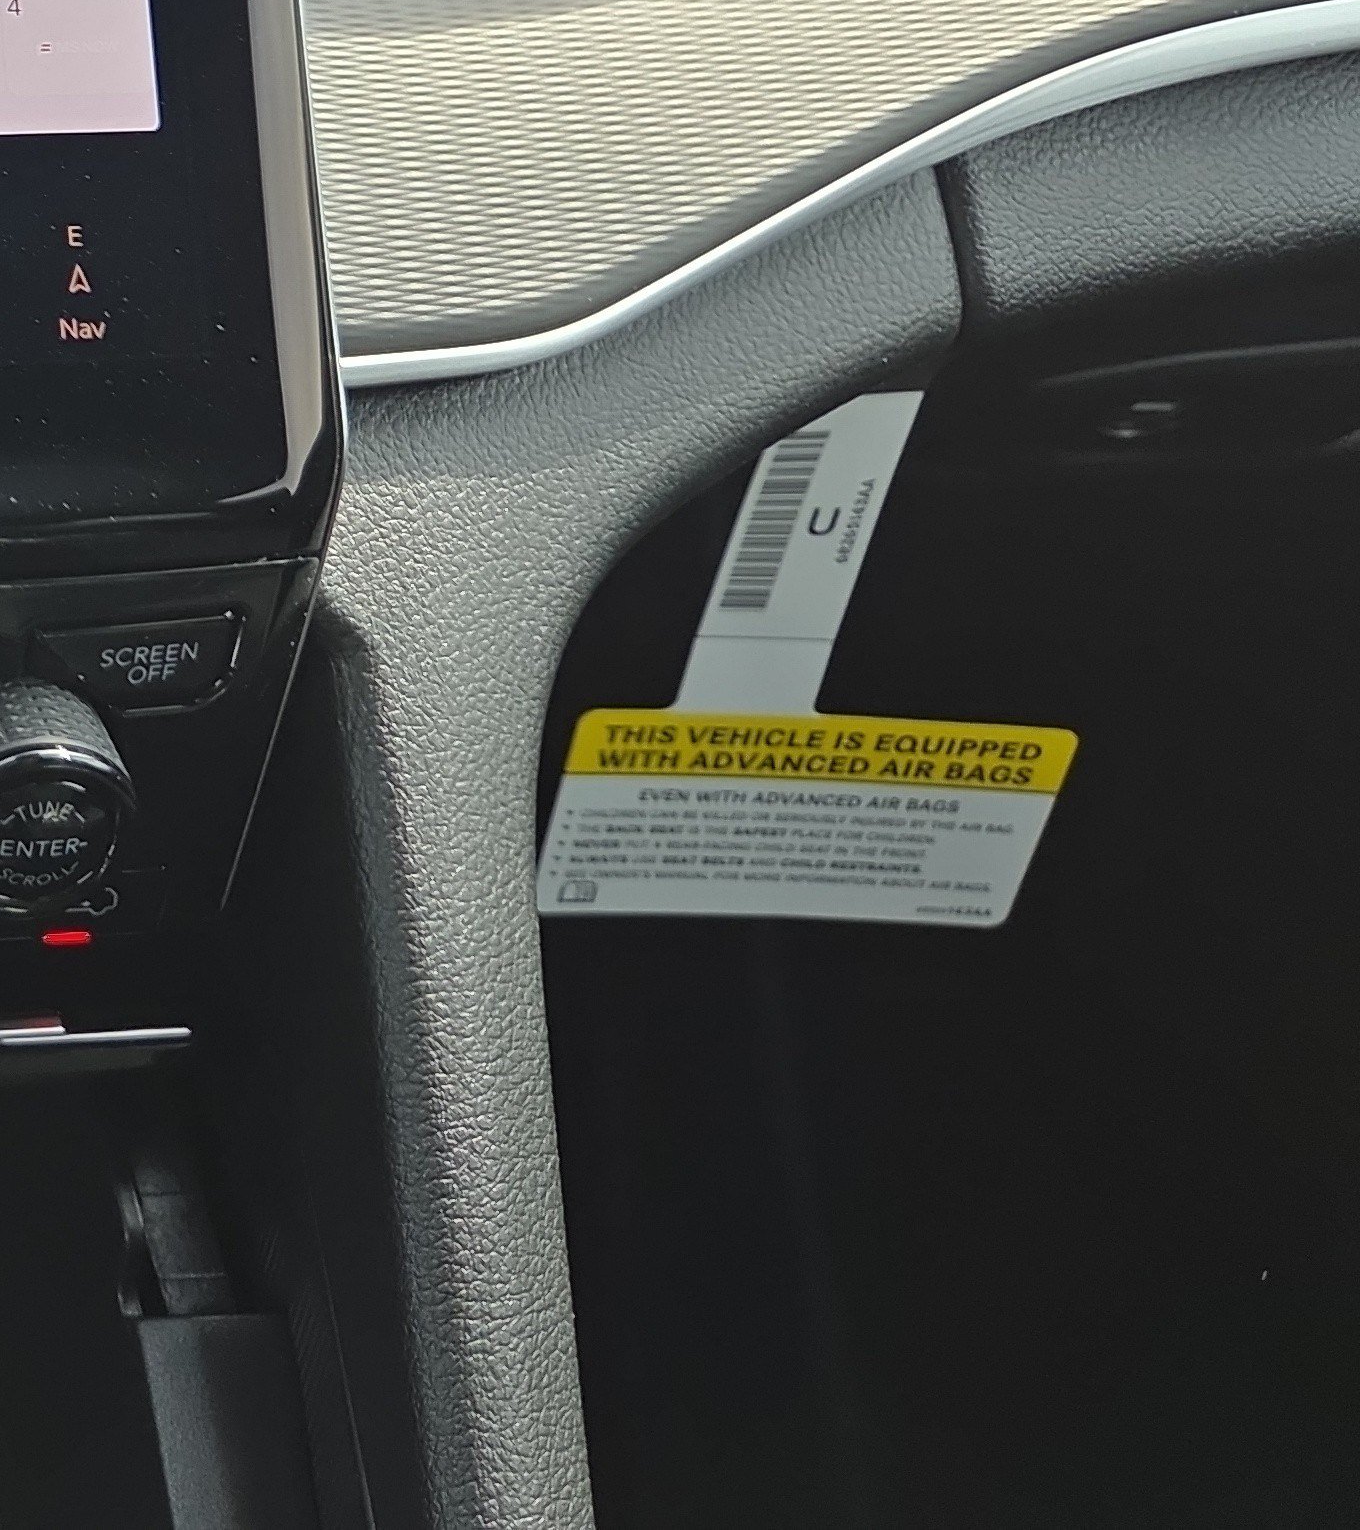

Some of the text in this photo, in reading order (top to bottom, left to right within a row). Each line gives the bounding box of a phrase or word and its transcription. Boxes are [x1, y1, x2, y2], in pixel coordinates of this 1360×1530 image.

[68, 225, 84, 248] E
[58, 317, 106, 343] Nav
[807, 506, 842, 536] U
[99, 641, 199, 669] SCREEN
[126, 662, 176, 686] OFF
[606, 724, 1043, 761] THIS VEHICLE IS EQUIPPED
[597, 748, 1035, 786] WITH ADVANCED AIR BAGS
[14, 800, 75, 824] TUNE
[637, 787, 961, 814] EVEN WITH ADVANCED AIR BAGS
[0, 836, 82, 859] ENTER
